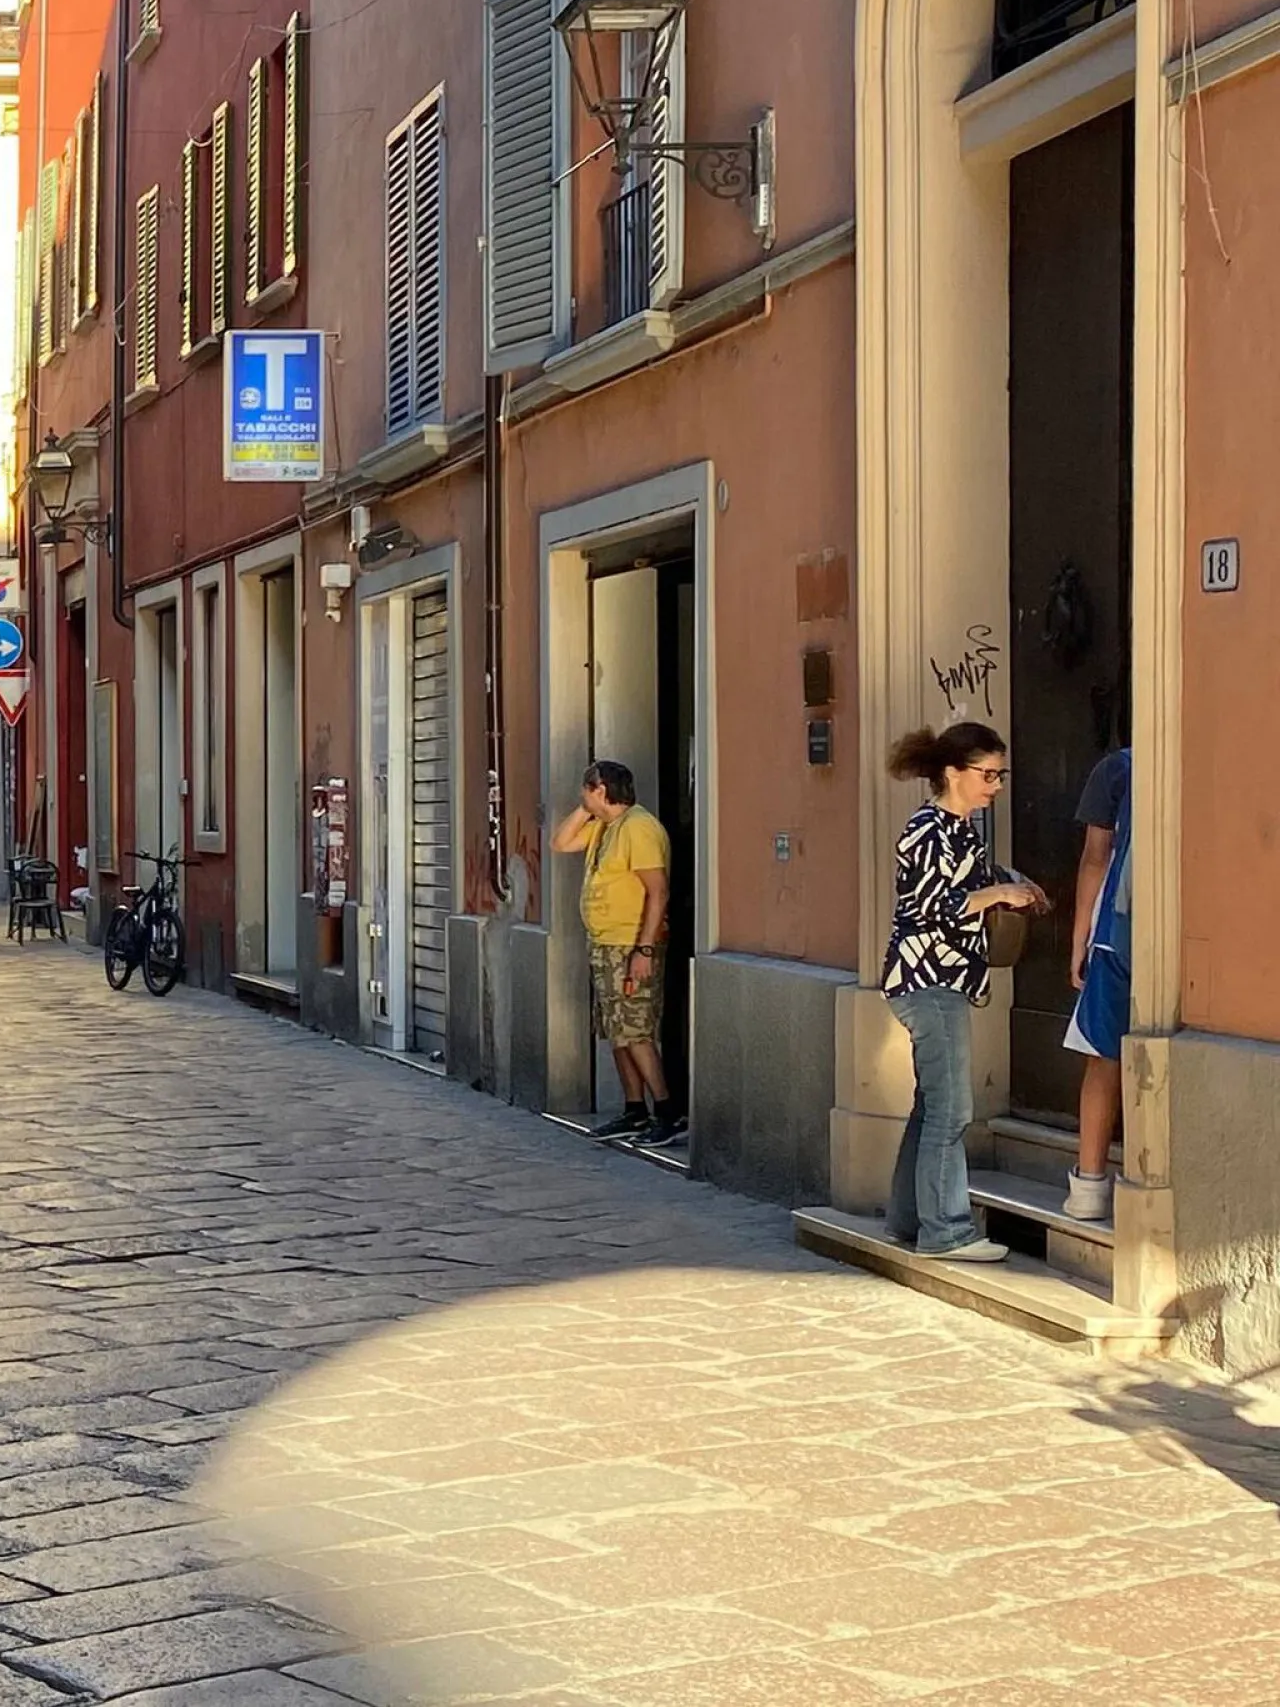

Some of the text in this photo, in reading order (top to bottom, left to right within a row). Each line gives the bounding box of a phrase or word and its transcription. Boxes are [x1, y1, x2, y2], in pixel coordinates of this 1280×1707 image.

[244, 339, 307, 410] T
[235, 423, 317, 433] TABACCHI
[1208, 550, 1229, 584] 18
